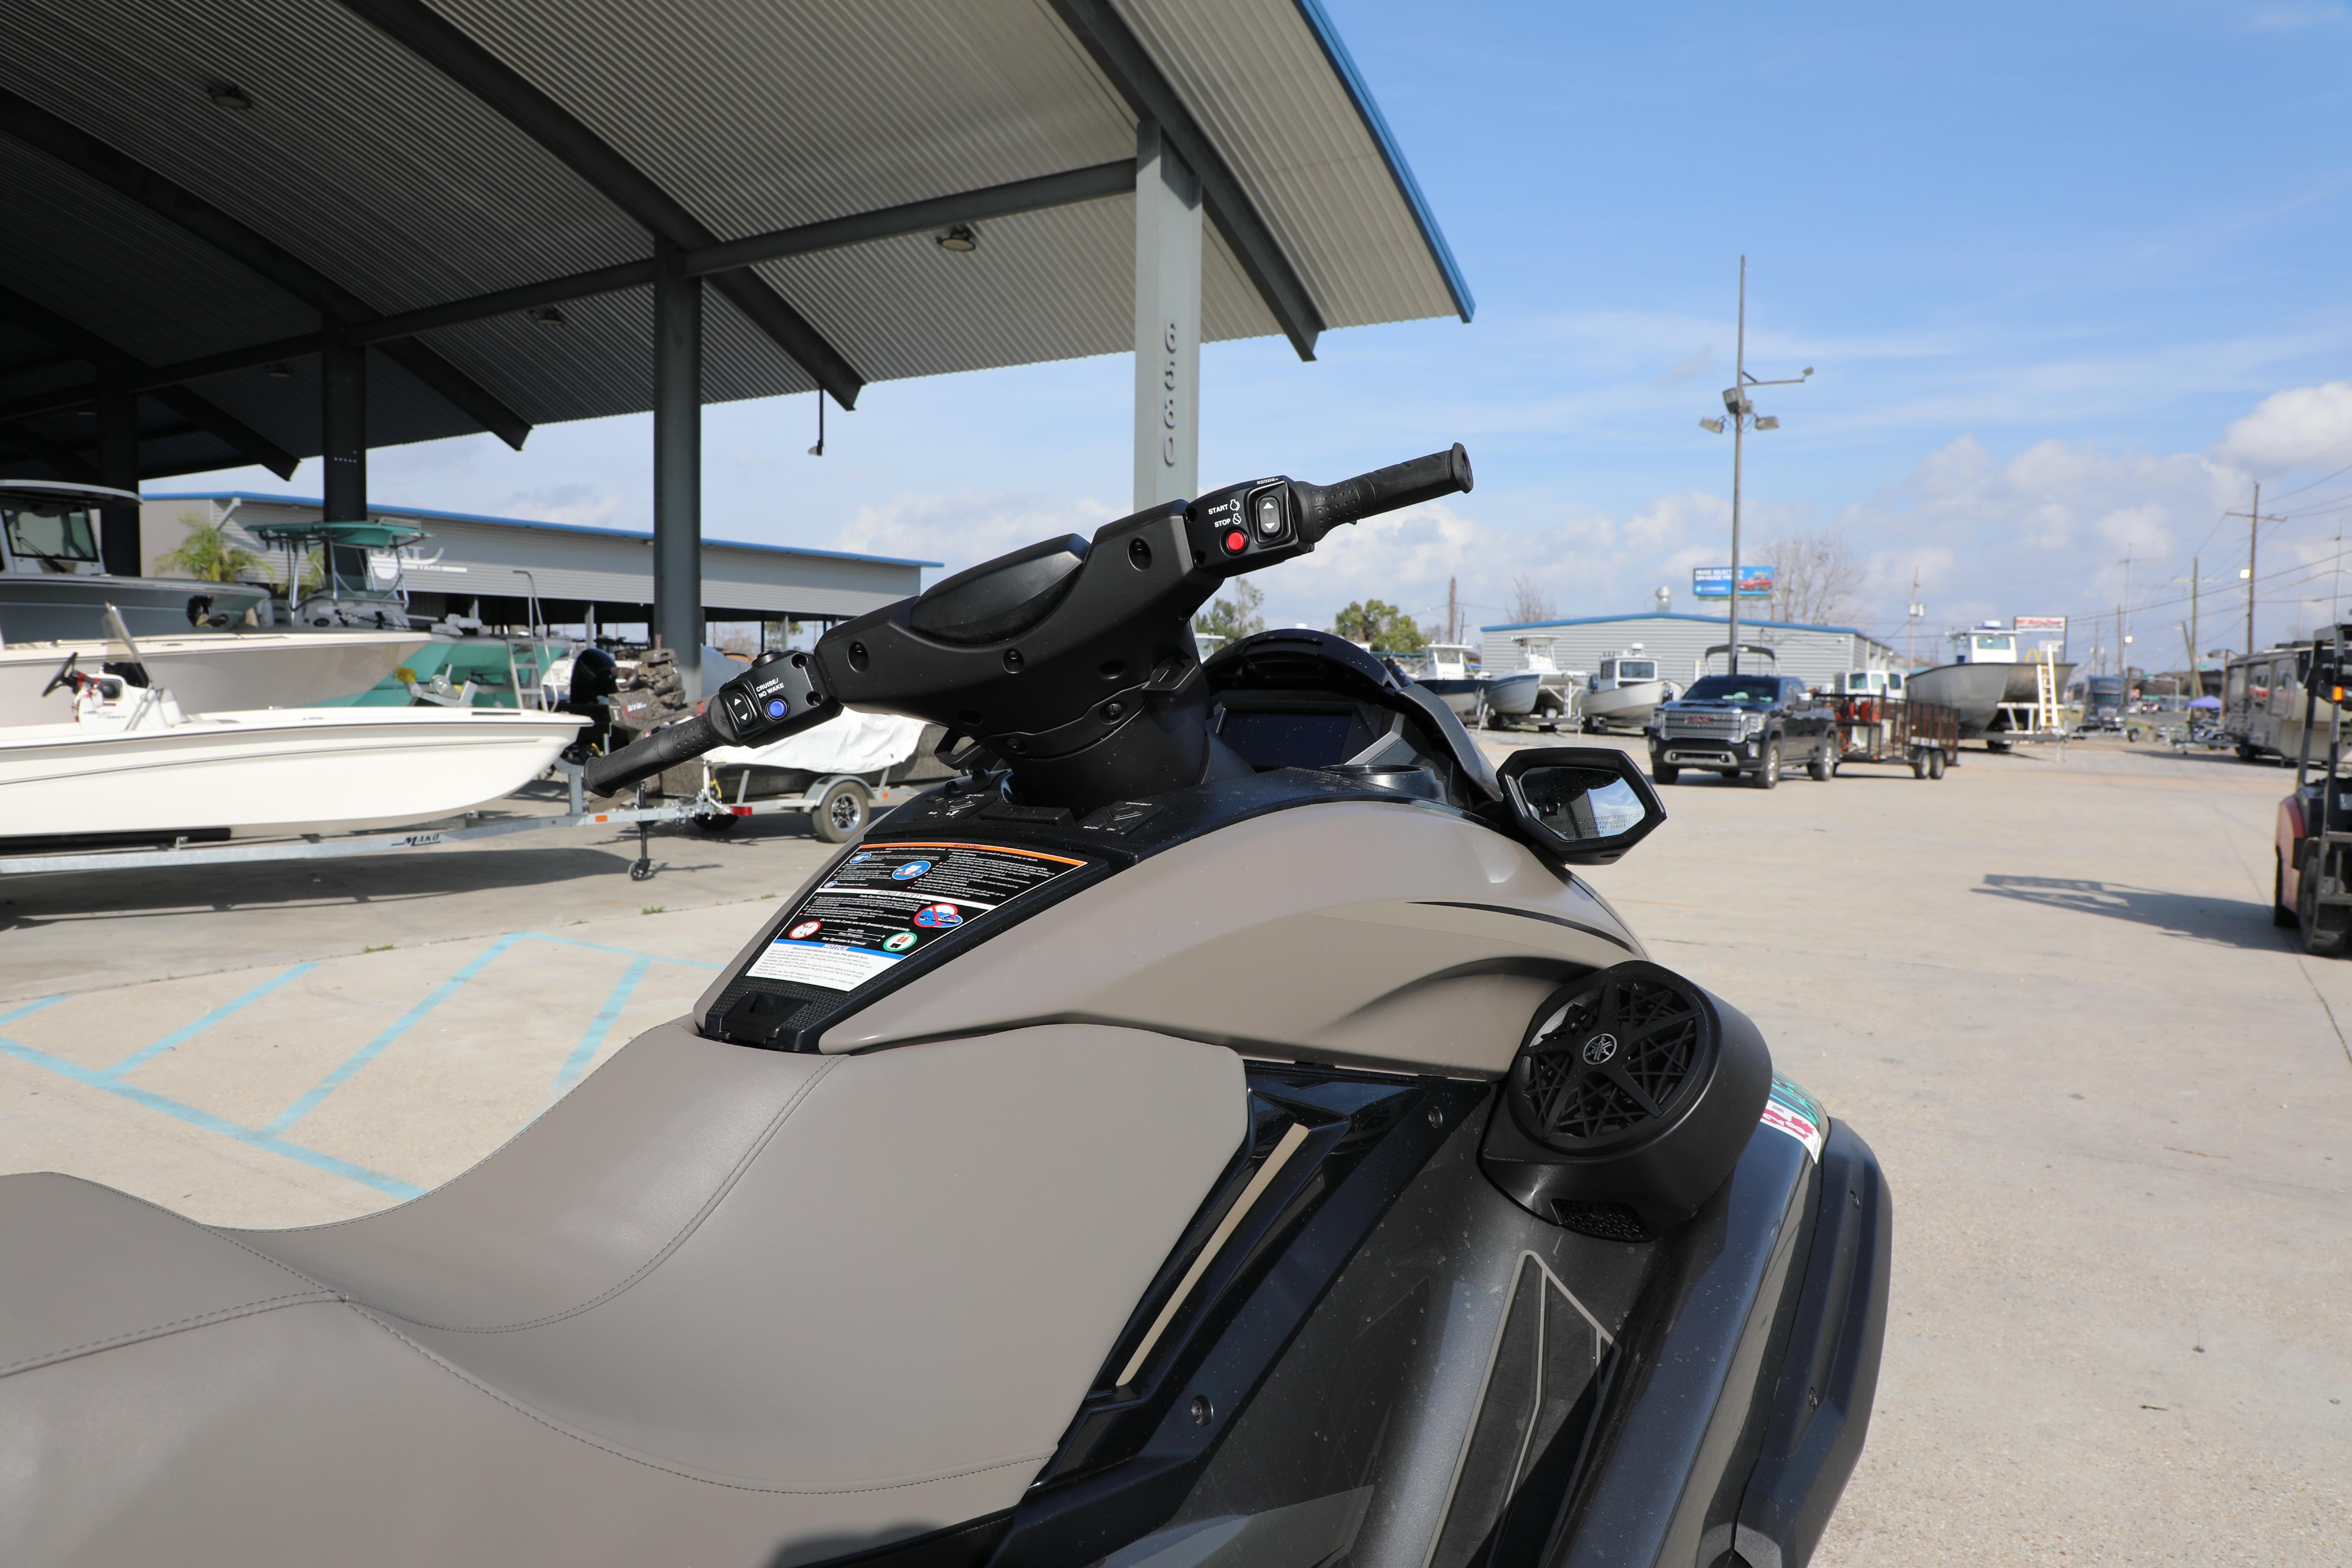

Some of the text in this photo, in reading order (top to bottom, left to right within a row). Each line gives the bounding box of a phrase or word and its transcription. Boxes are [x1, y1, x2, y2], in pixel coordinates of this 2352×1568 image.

[1208, 504, 1228, 514] START
[1214, 518, 1231, 528] STOP
[756, 678, 778, 692] CRUISE/
[767, 683, 784, 694] WAKE
